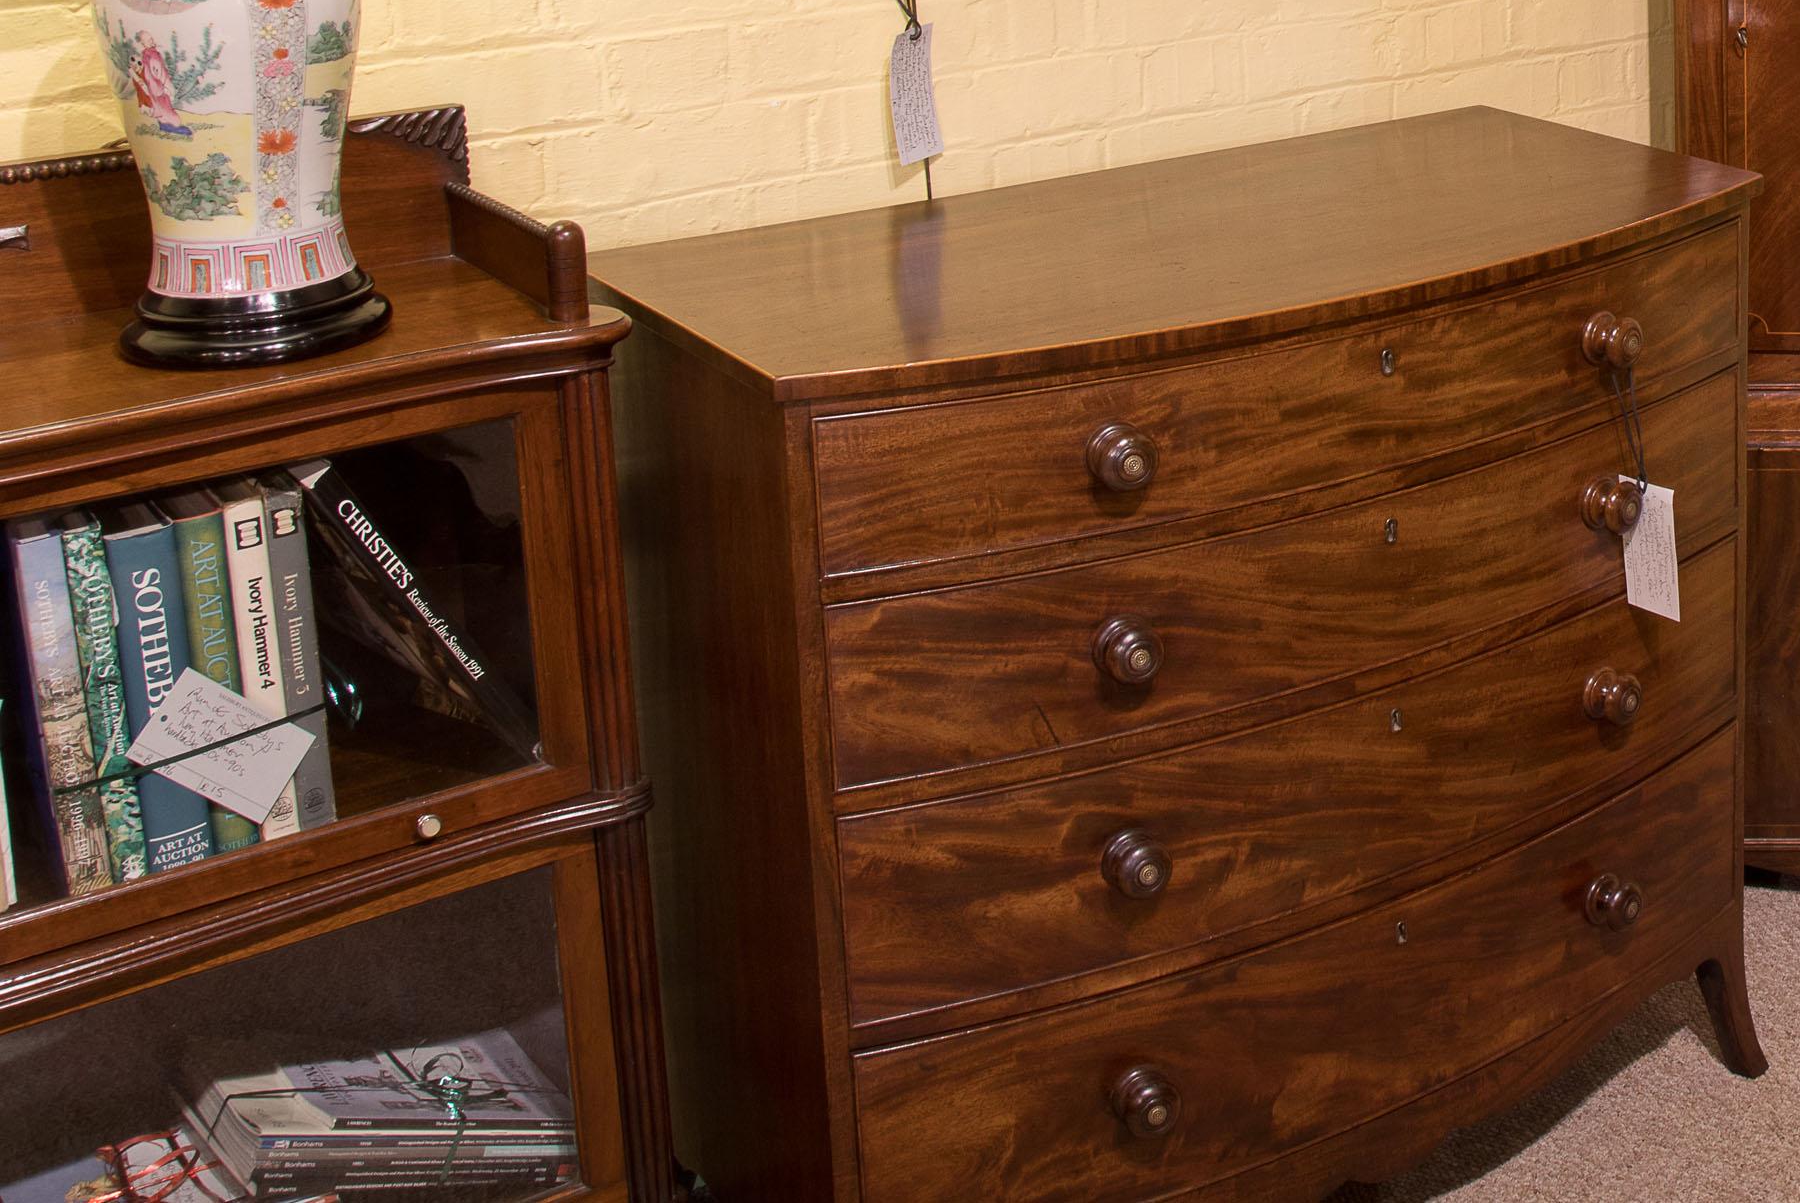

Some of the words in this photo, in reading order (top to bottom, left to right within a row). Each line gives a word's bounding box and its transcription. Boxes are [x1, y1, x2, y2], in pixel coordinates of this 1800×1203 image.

[337, 499, 414, 590] CHRISTIE'S
[190, 540, 220, 588] ART
[198, 593, 224, 621] AT
[248, 576, 263, 615] Ivory
[284, 572, 299, 612] Ivory
[406, 588, 434, 621] Review
[83, 562, 117, 678] SOTHEBY'S
[427, 612, 445, 628] of
[435, 621, 450, 639] the
[131, 567, 175, 712] SOTHEB
[252, 615, 271, 677] Hammer
[288, 616, 307, 681] Hammer
[446, 634, 469, 666] Season
[49, 667, 66, 696] ART
[261, 679, 276, 690] 4
[464, 658, 485, 681] 1991
[107, 683, 119, 700] Art
[110, 702, 121, 713] at
[112, 716, 126, 755] Auction
[153, 839, 209, 865] AUCTION
[158, 838, 185, 854] ART
[186, 831, 203, 845] AT
[292, 1140, 324, 1148] Bonhams
